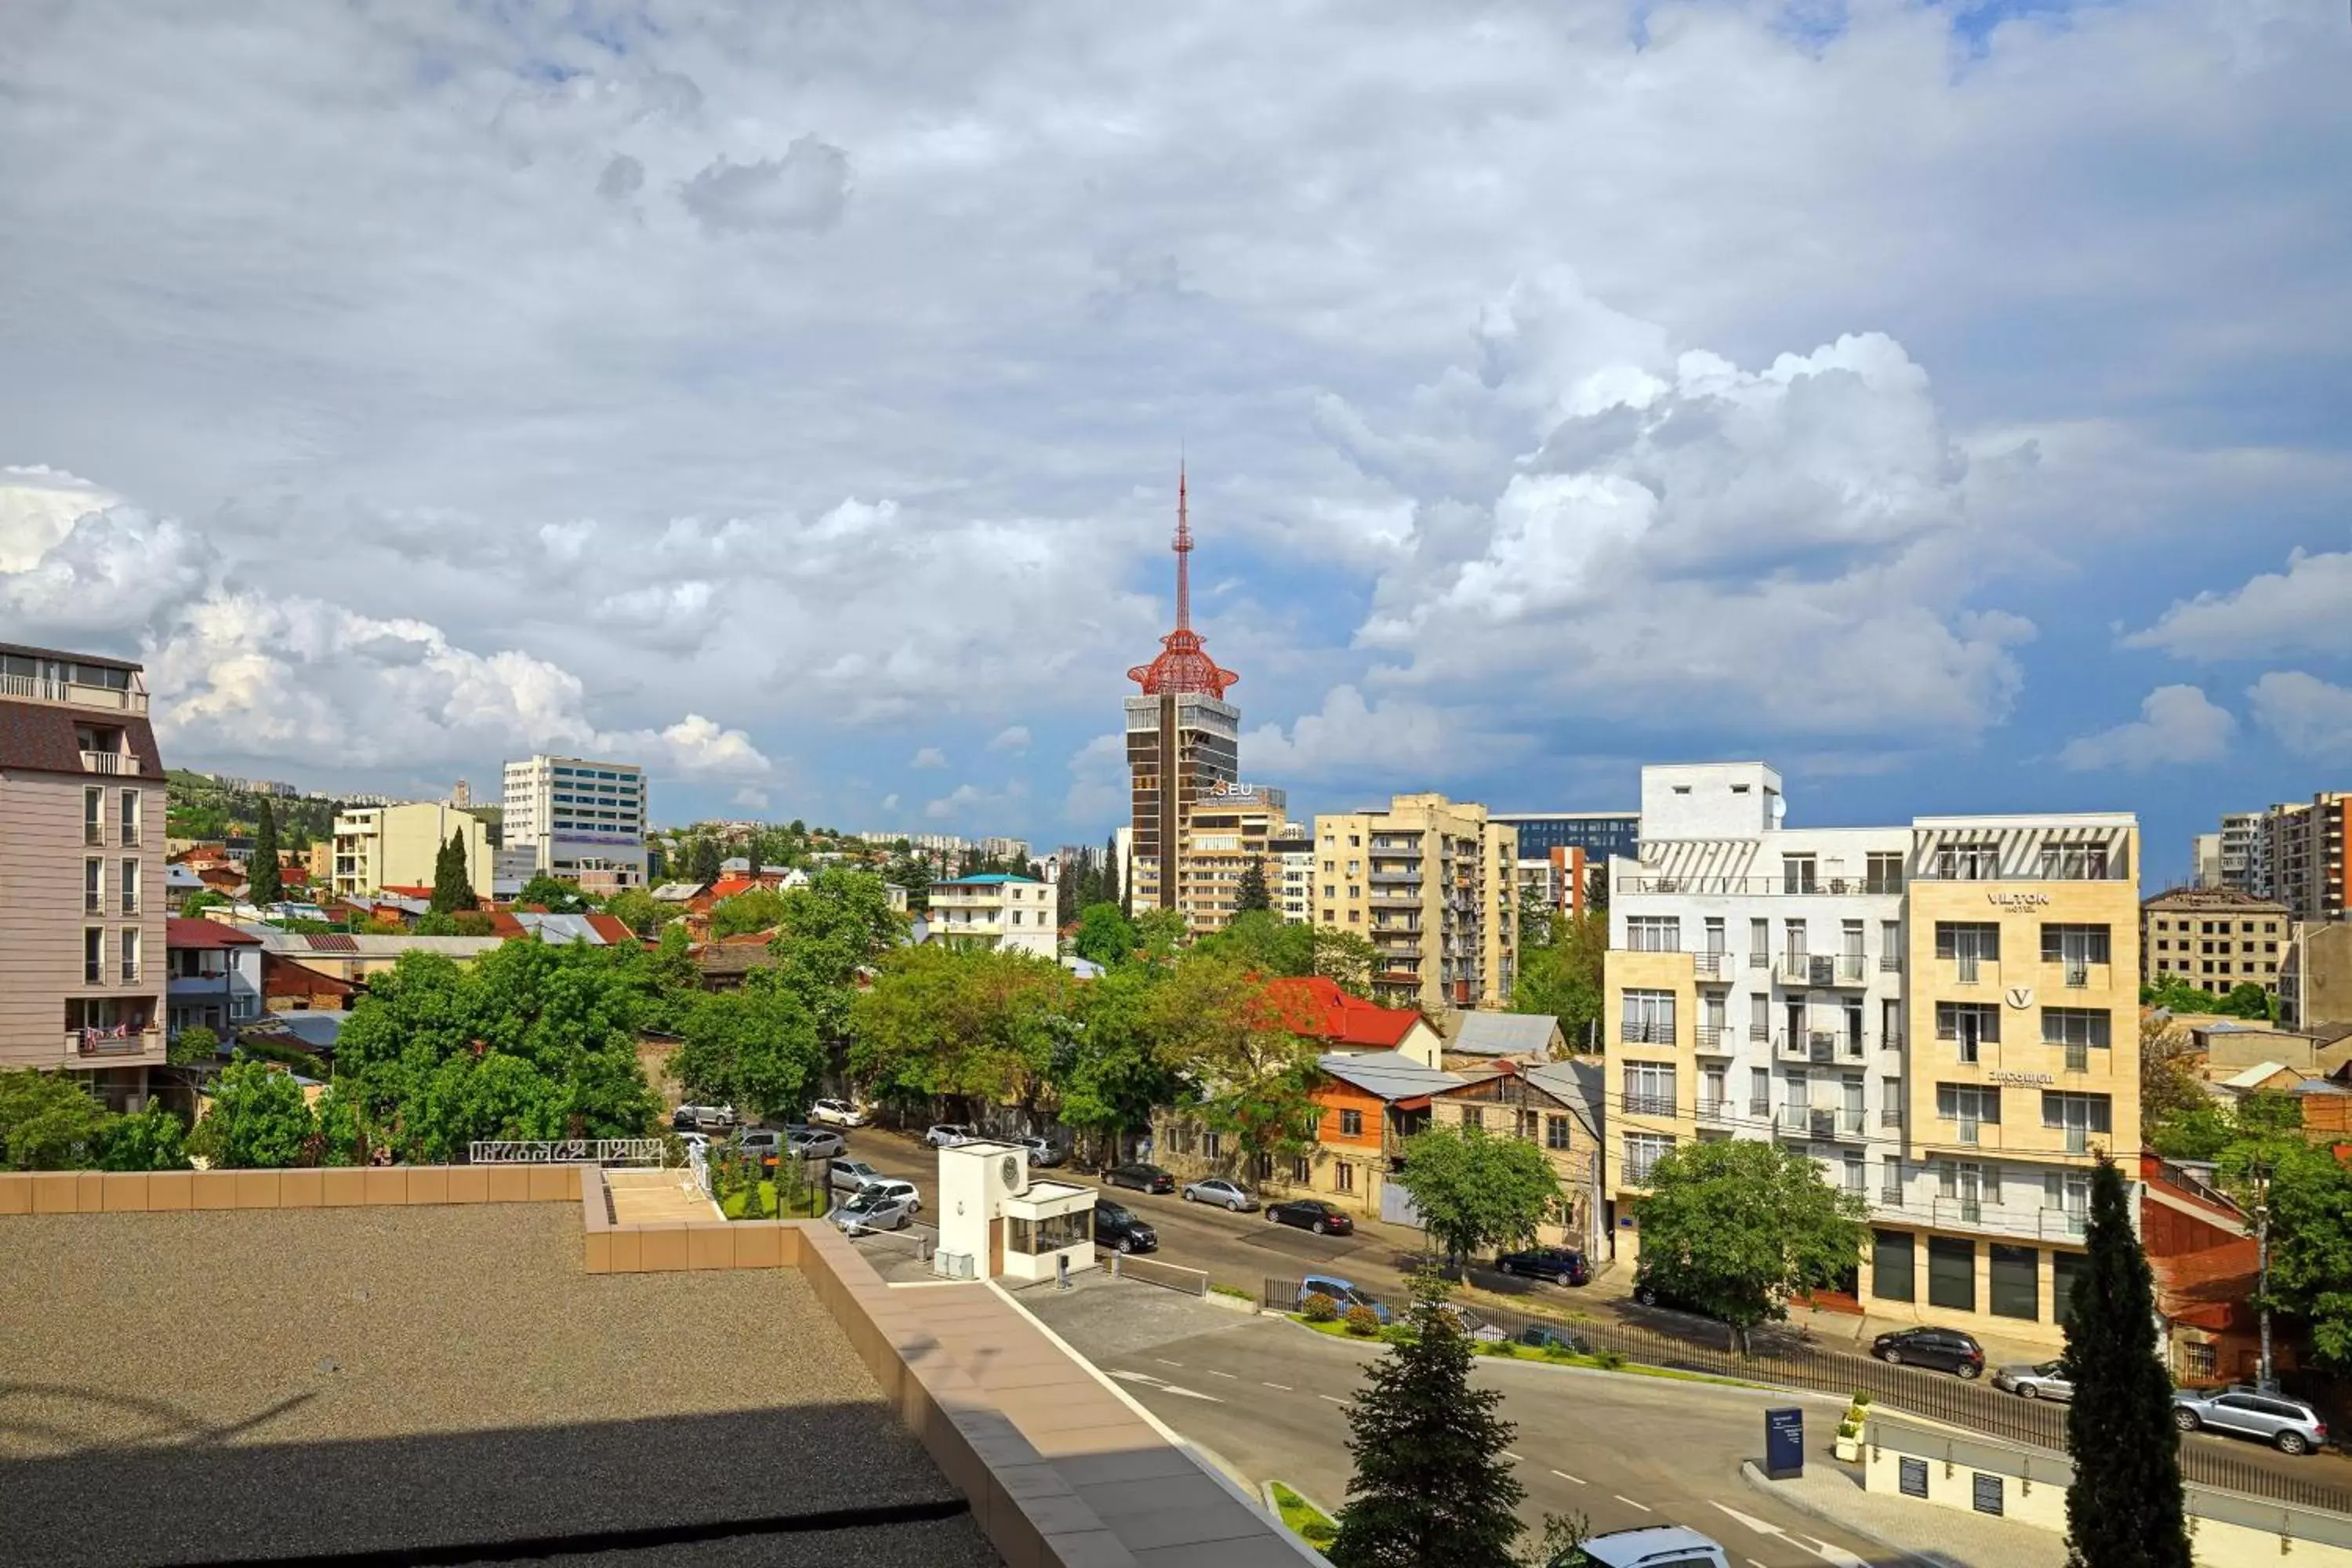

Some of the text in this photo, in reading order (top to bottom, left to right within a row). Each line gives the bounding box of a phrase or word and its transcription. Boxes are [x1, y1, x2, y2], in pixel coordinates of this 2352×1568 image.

[1216, 783, 1252, 795] SEU
[1987, 892, 2049, 905] VILTON
[2008, 989, 2032, 1005] V
